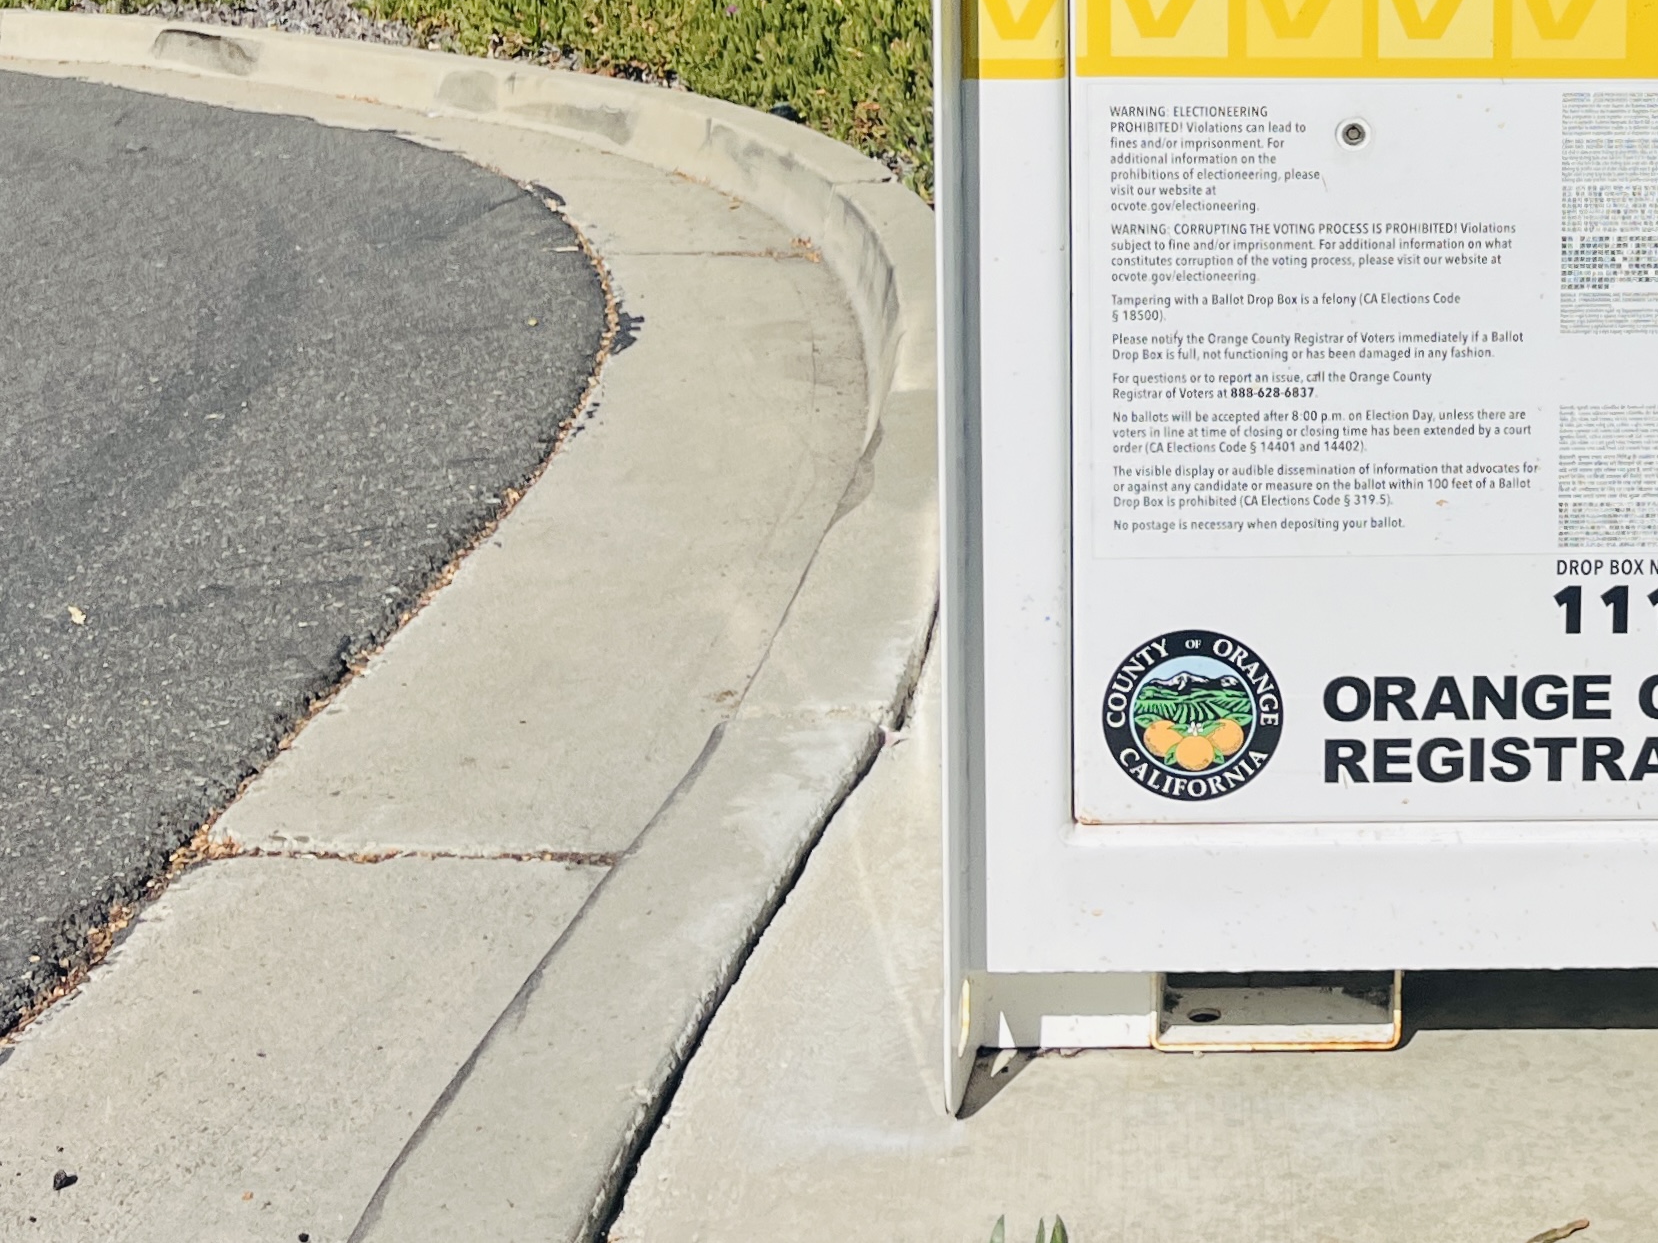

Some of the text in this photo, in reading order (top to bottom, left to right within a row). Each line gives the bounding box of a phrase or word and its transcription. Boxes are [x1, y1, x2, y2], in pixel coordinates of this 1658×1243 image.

[1172, 105, 1267, 117] ELECTIONEERING
[1110, 120, 1306, 134] PROHIBITED! Violations can lead to
[1110, 138, 1137, 149] fines
[1140, 138, 1177, 151] and/or
[1266, 137, 1285, 148] For
[1110, 153, 1276, 165] additional information on the
[1110, 170, 1179, 183] prohibitions
[1182, 169, 1194, 180] of
[1283, 168, 1320, 182] please
[1173, 223, 1247, 235] CORRUPTING
[1249, 223, 1270, 234] THE
[1272, 222, 1315, 234] VOTING
[1318, 222, 1369, 234] PROCESS
[1371, 222, 1382, 233] IS
[1385, 221, 1457, 233] PROHIBITED!
[1459, 221, 1516, 233] Violations
[1110, 240, 1151, 254] subject
[1153, 240, 1165, 251] to
[1167, 240, 1190, 251] fine
[1192, 240, 1230, 252] and/or
[1318, 239, 1336, 250] For
[1338, 239, 1395, 249] additional
[1398, 238, 1464, 249] information
[1467, 240, 1481, 249] on
[1484, 238, 1512, 248] what
[1110, 253, 1501, 269] constitutes corruption of the voting process, please visit our website at
[1111, 331, 1523, 347] Please notify the Orange County Registrar of Voters immediately if a Ballot
[1111, 371, 1432, 387] For questions or to report an issue, call the Orange County
[1112, 388, 1162, 402] Registrar
[1165, 388, 1176, 399] of
[1178, 387, 1214, 398] Voters
[1216, 387, 1227, 398] at
[1112, 411, 1128, 422] No
[1130, 411, 1168, 422] ballots
[1171, 411, 1191, 422] will
[1194, 411, 1209, 422] be
[1211, 410, 1260, 424] accepted
[1263, 410, 1289, 421] after
[1348, 412, 1362, 421] on
[1365, 410, 1409, 420] Election
[1411, 409, 1435, 423] Day,
[1438, 409, 1474, 420] unless
[1476, 409, 1506, 420] there
[1508, 410, 1526, 420] are
[1112, 442, 1142, 453] order
[1144, 442, 1164, 455] (CA
[1166, 442, 1216, 453] Elections
[1218, 441, 1247, 452] Code
[1249, 441, 1256, 454] §
[1260, 441, 1295, 452] 14401
[1298, 441, 1320, 452] and
[1112, 463, 1538, 480] The visible display or audible dissemination of information that advocates for
[1112, 496, 1140, 510] Drop
[1142, 496, 1163, 507] Box
[1166, 495, 1175, 507] is
[1178, 495, 1236, 510] prohibited
[1239, 495, 1258, 508] (CA
[1260, 495, 1310, 506] Elections
[1312, 494, 1340, 506] Code
[1343, 494, 1350, 508] §
[1113, 518, 1405, 533] No postage is necessary when depositing your ballot.
[1556, 559, 1604, 576] DROP
[1610, 558, 1645, 576] BOX
[1106, 638, 1279, 728] COUNTY OF ORANGE
[1323, 674, 1612, 722] ORANGE
[1119, 747, 1269, 798] CALIFORNIA
